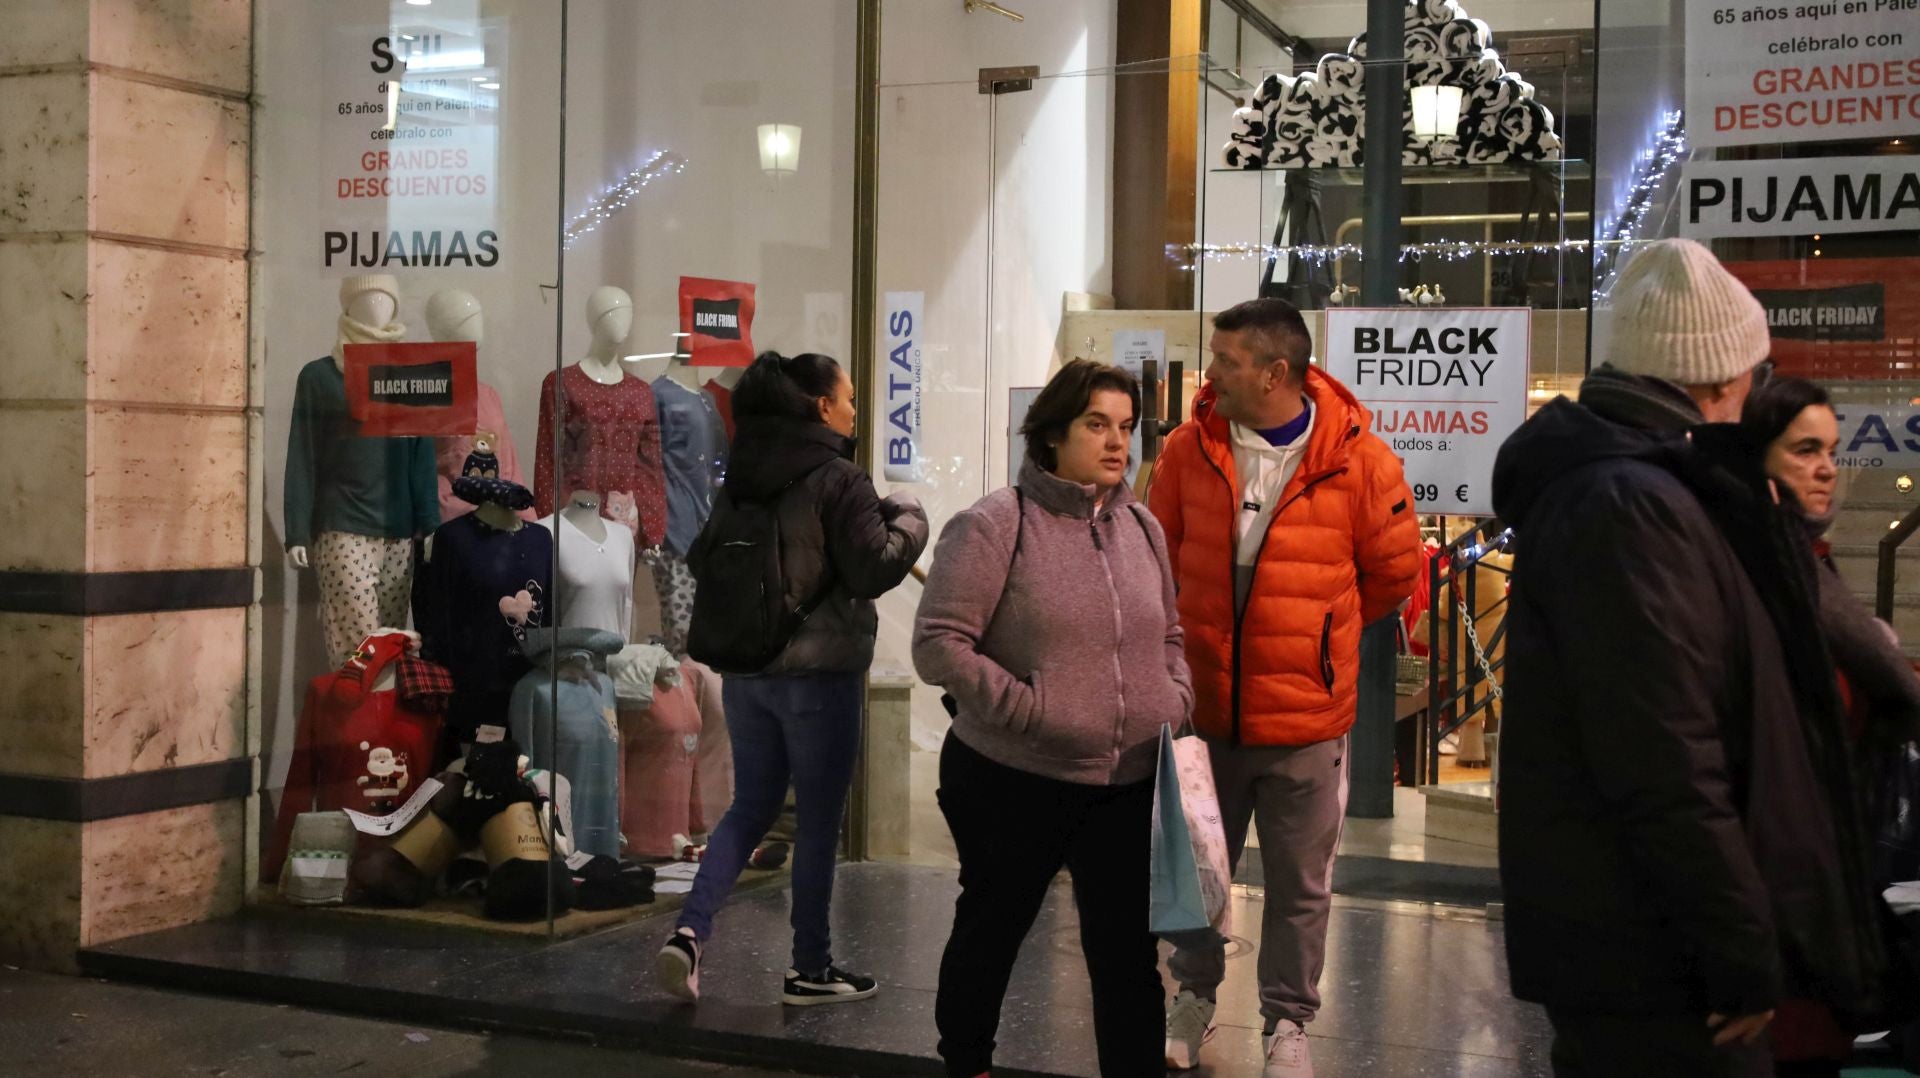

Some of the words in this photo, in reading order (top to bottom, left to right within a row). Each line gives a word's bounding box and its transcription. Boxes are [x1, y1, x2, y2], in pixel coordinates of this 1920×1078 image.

[1713, 9, 1736, 25] 65
[1741, 6, 1788, 22] años
[1843, 1, 1867, 14] en
[1768, 33, 1859, 54] celébralo
[1865, 33, 1903, 47] con
[338, 103, 352, 115] 65
[355, 101, 385, 114] años
[417, 103, 431, 112] en
[430, 127, 453, 138] con
[361, 149, 468, 171] GRANDES
[338, 175, 487, 199] DESCUENTOS
[324, 230, 499, 268] PIJAMAS
[696, 312, 718, 327] BLACK
[1768, 307, 1813, 327] LACK
[1816, 306, 1878, 326] FRIDAY
[1354, 327, 1498, 355] BLACK
[1356, 359, 1495, 387] FRIDAY
[374, 379, 408, 395] BLACK
[410, 379, 448, 394] FRIDAY
[889, 310, 913, 465] BATAS
[1371, 409, 1489, 435] IJAMAS
[1393, 438, 1433, 451] todos
[1438, 440, 1452, 451] a:
[1455, 484, 1468, 502] €
